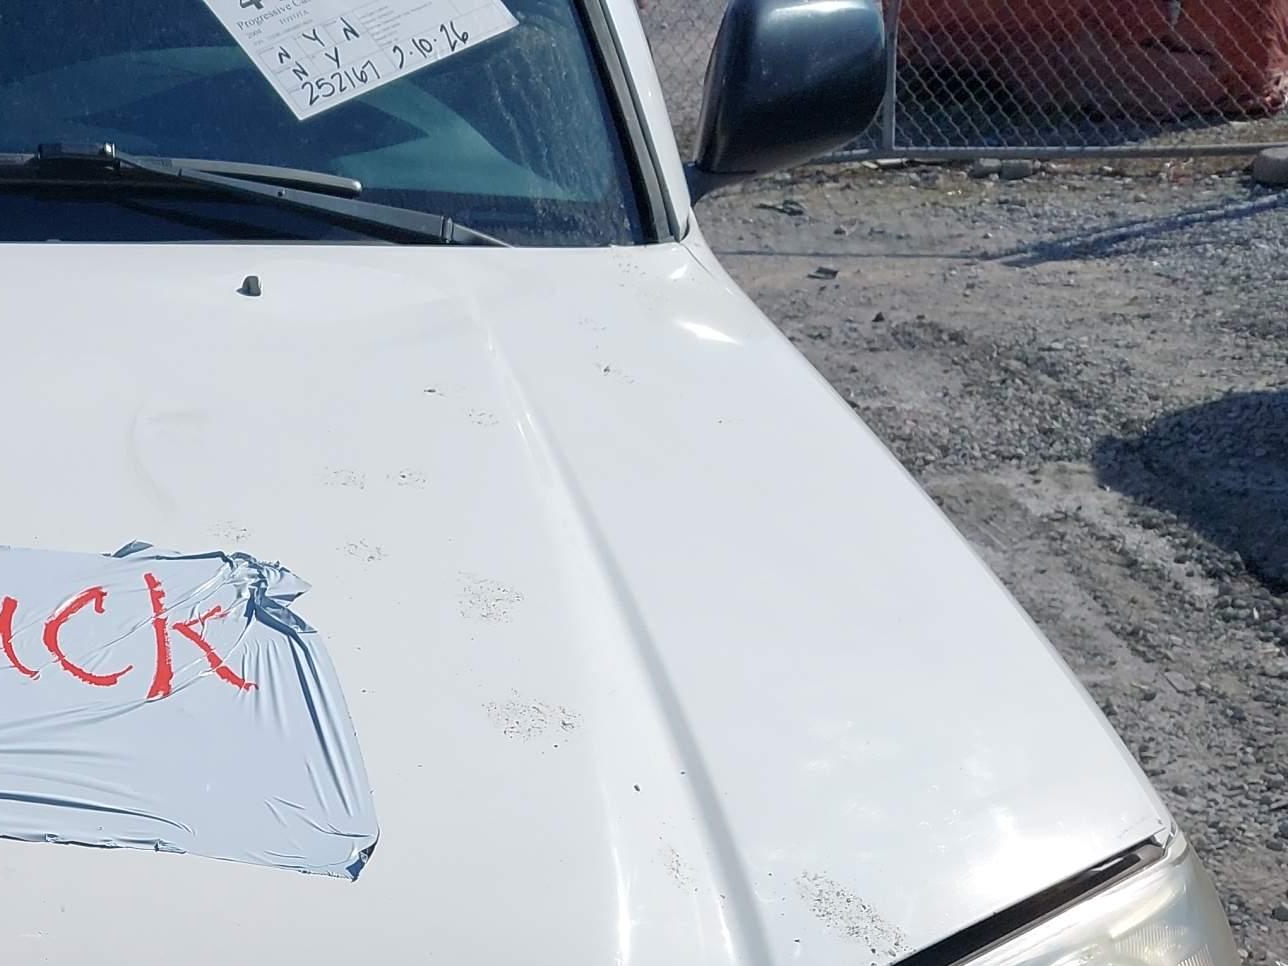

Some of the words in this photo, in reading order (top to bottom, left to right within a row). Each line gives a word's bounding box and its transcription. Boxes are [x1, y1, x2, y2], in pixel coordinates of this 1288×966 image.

[235, 3, 292, 30] Progressive
[278, 46, 292, 64] N
[302, 28, 326, 47] Y
[340, 16, 360, 41] N
[292, 60, 309, 81] N
[324, 46, 341, 69] Y
[300, 60, 381, 106] 252167
